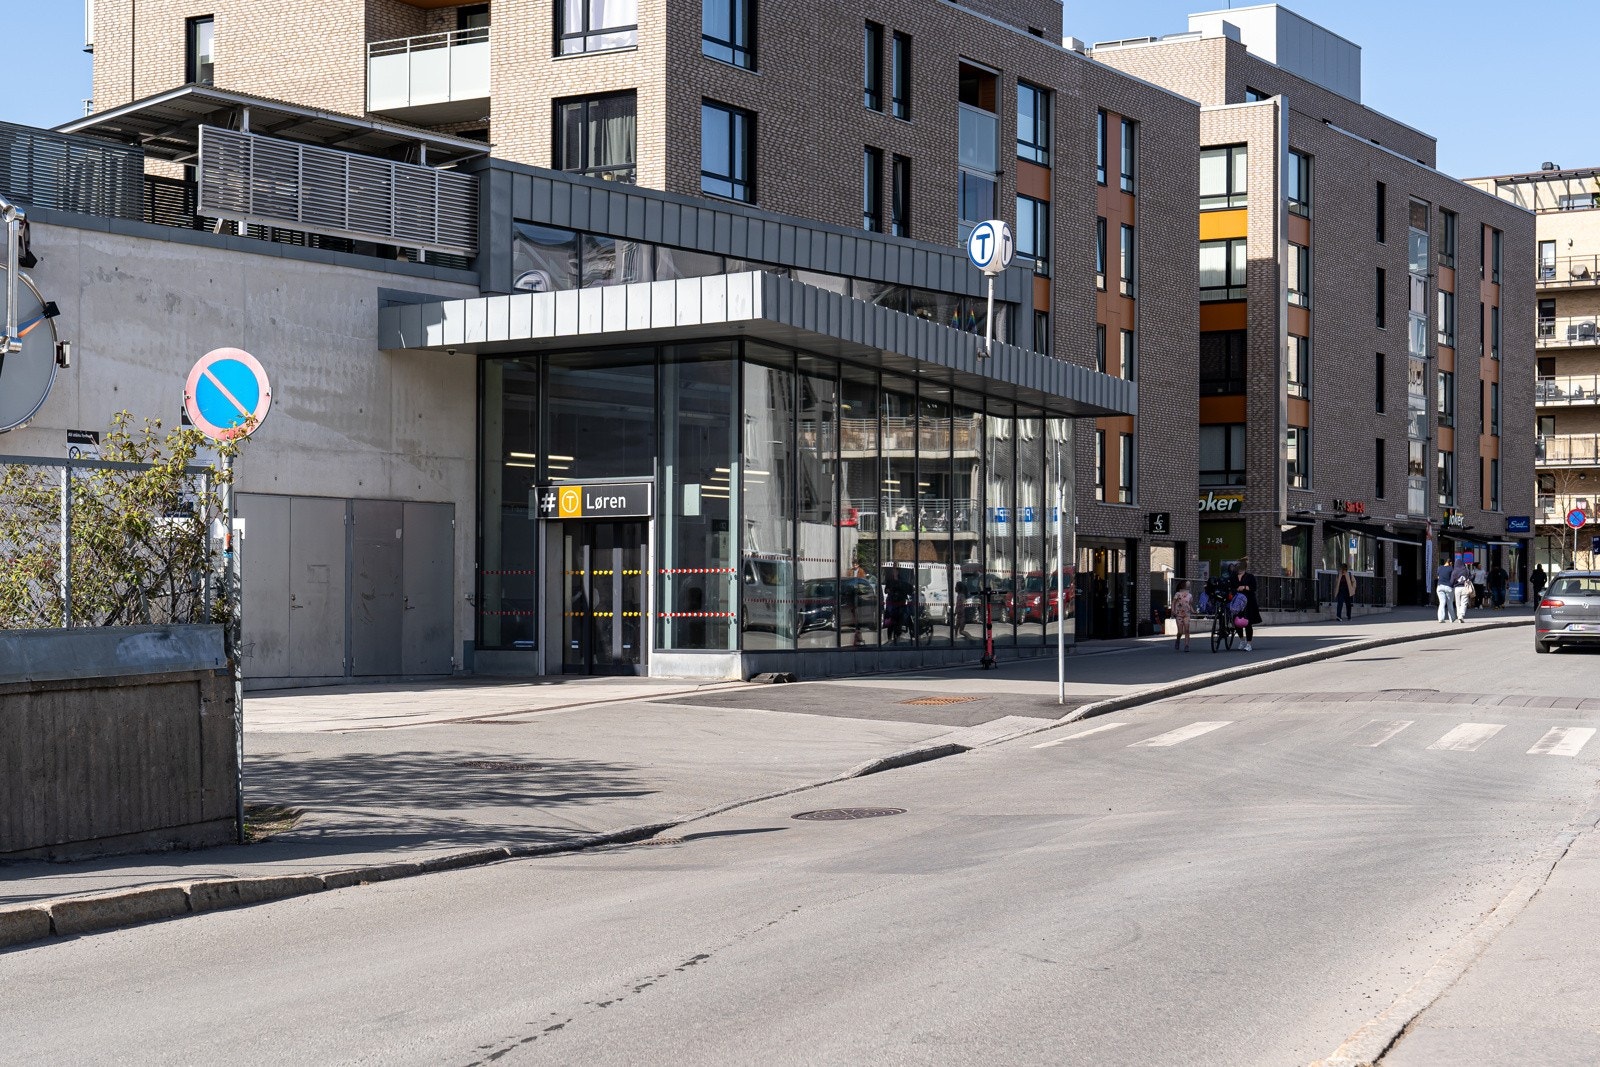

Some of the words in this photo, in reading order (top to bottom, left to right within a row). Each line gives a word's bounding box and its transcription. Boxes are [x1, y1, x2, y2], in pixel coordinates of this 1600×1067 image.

[976, 233, 990, 259] T
[1003, 235, 1010, 261] T
[586, 494, 626, 510] Løren
[1199, 491, 1238, 511] oker
